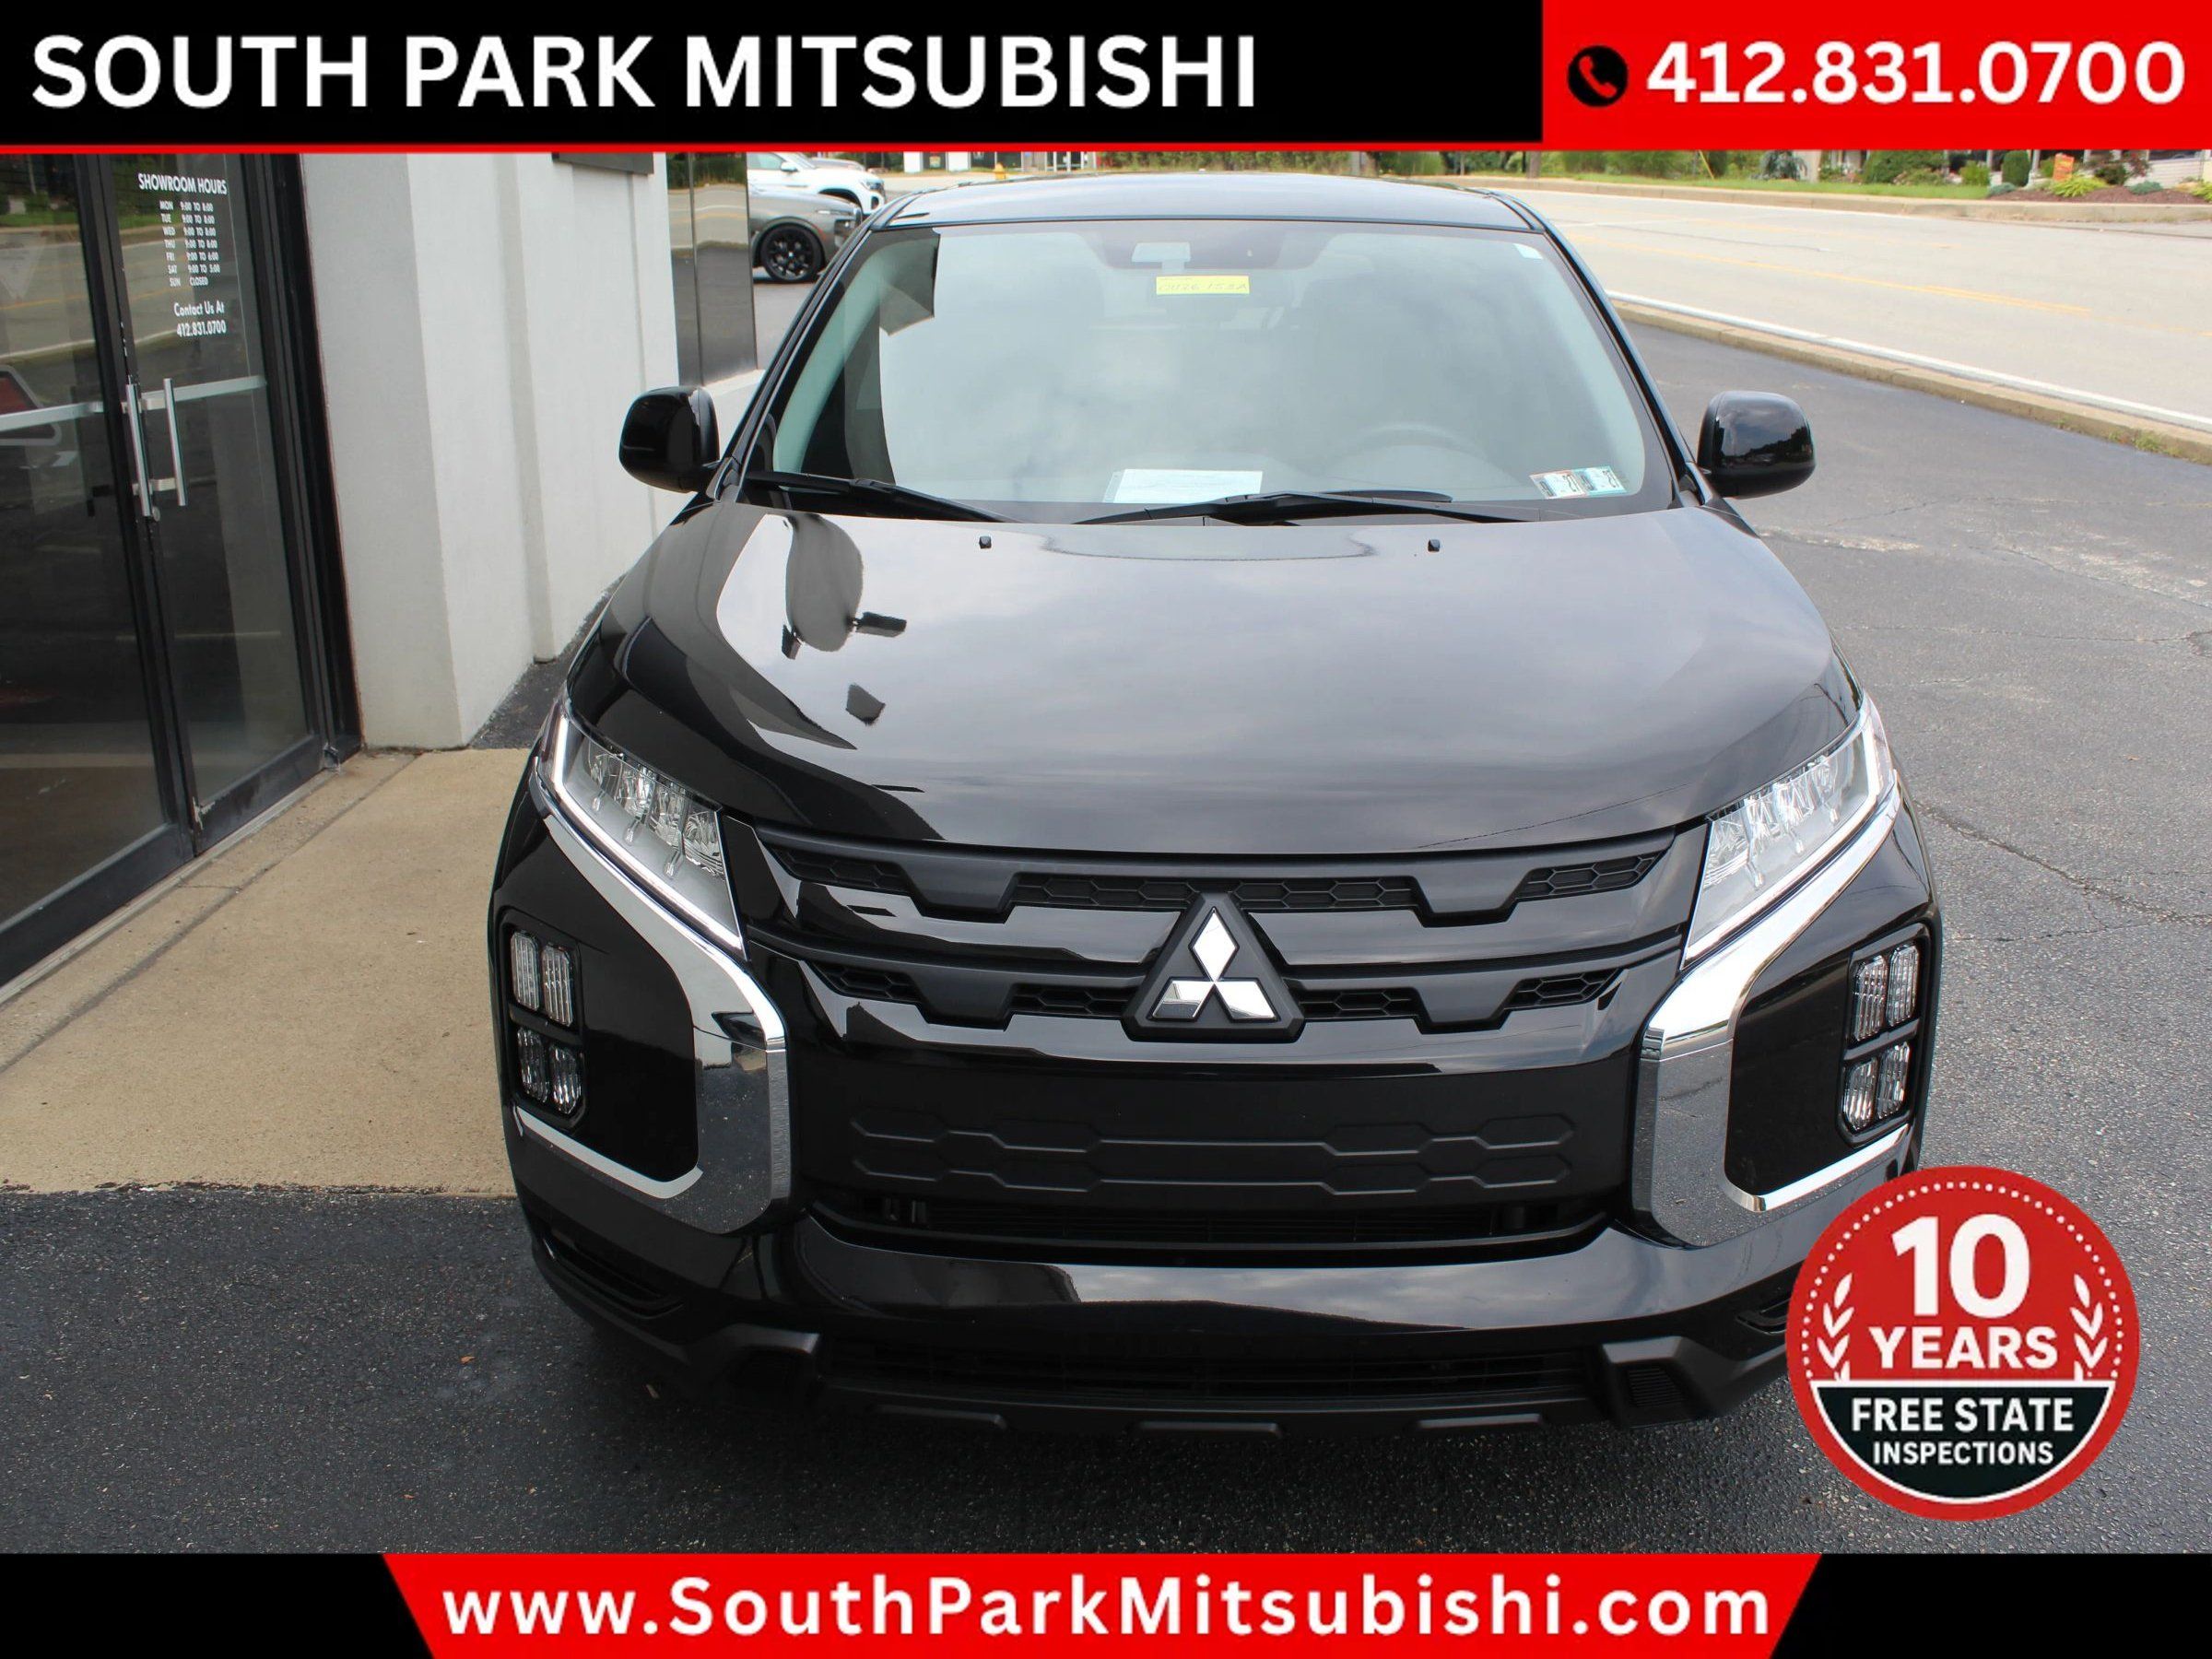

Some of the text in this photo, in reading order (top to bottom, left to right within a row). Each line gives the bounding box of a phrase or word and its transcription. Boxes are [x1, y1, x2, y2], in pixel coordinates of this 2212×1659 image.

[138, 173, 228, 194] SHOWROOM HOURS
[159, 200, 174, 210] MON
[180, 201, 192, 211] 9:00
[194, 202, 201, 212] TO
[160, 213, 171, 223] TUE
[182, 214, 193, 224] 9:00
[194, 214, 202, 224] TO
[162, 226, 176, 236] WED
[183, 227, 194, 236] 9:00
[196, 227, 204, 236] TO
[164, 240, 176, 249] THU
[184, 240, 196, 249] 9:00
[197, 240, 206, 249] TO
[166, 252, 175, 261] FRI
[186, 252, 197, 261] 9:00
[198, 252, 206, 261] TO
[168, 265, 177, 274] SAT
[188, 265, 199, 274] 9:00
[200, 264, 207, 273] TO
[170, 276, 208, 287] SUN CLOSED
[174, 300, 225, 317] Contact Us At
[176, 320, 227, 337] 412.831.0700
